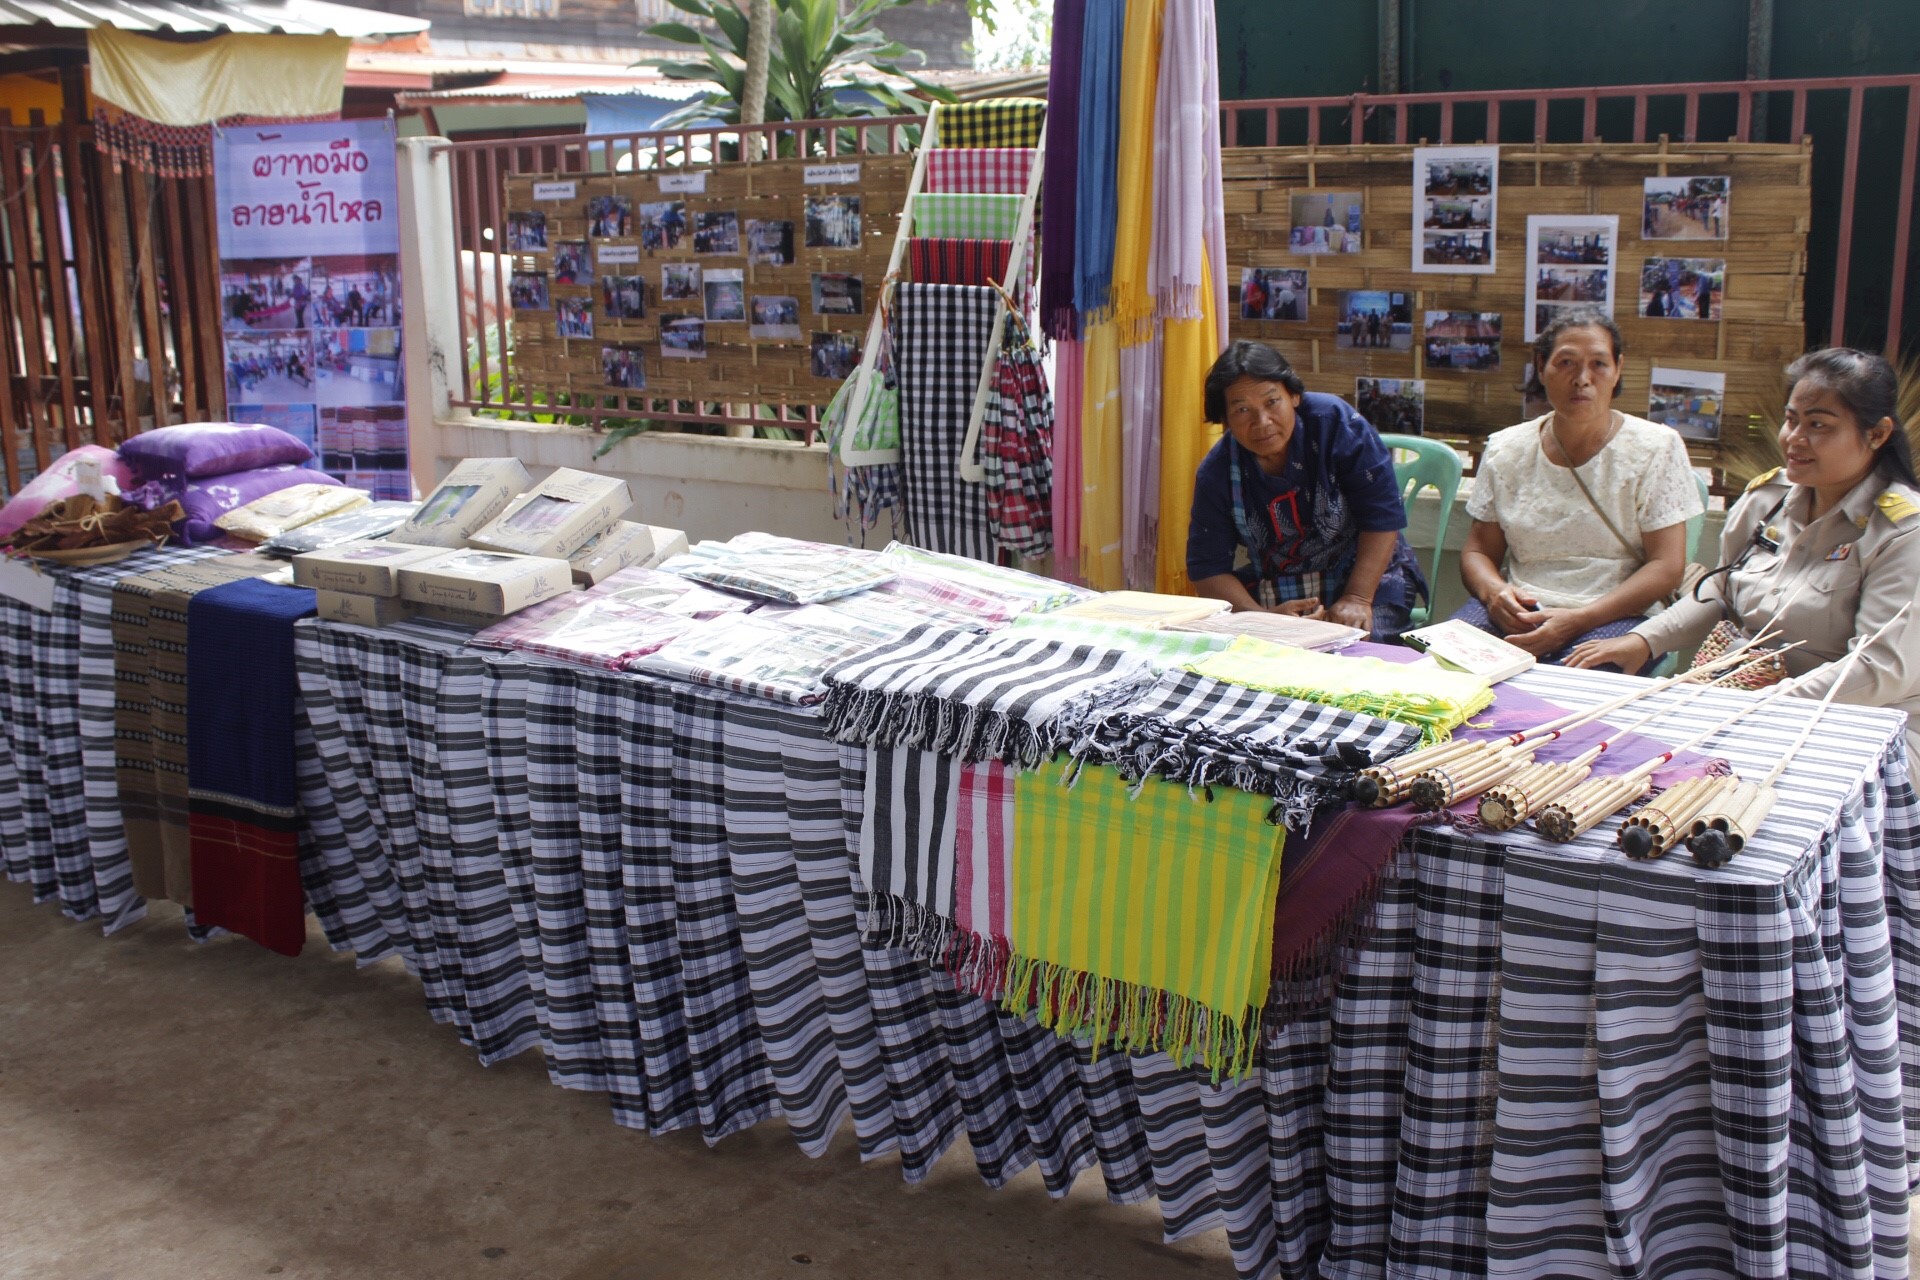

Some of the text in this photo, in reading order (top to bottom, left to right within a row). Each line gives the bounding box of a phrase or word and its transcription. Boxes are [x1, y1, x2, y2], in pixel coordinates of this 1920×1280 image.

[253, 132, 369, 177] ผ้าทอมือ
[232, 180, 382, 226] ลายน้ำไหล
